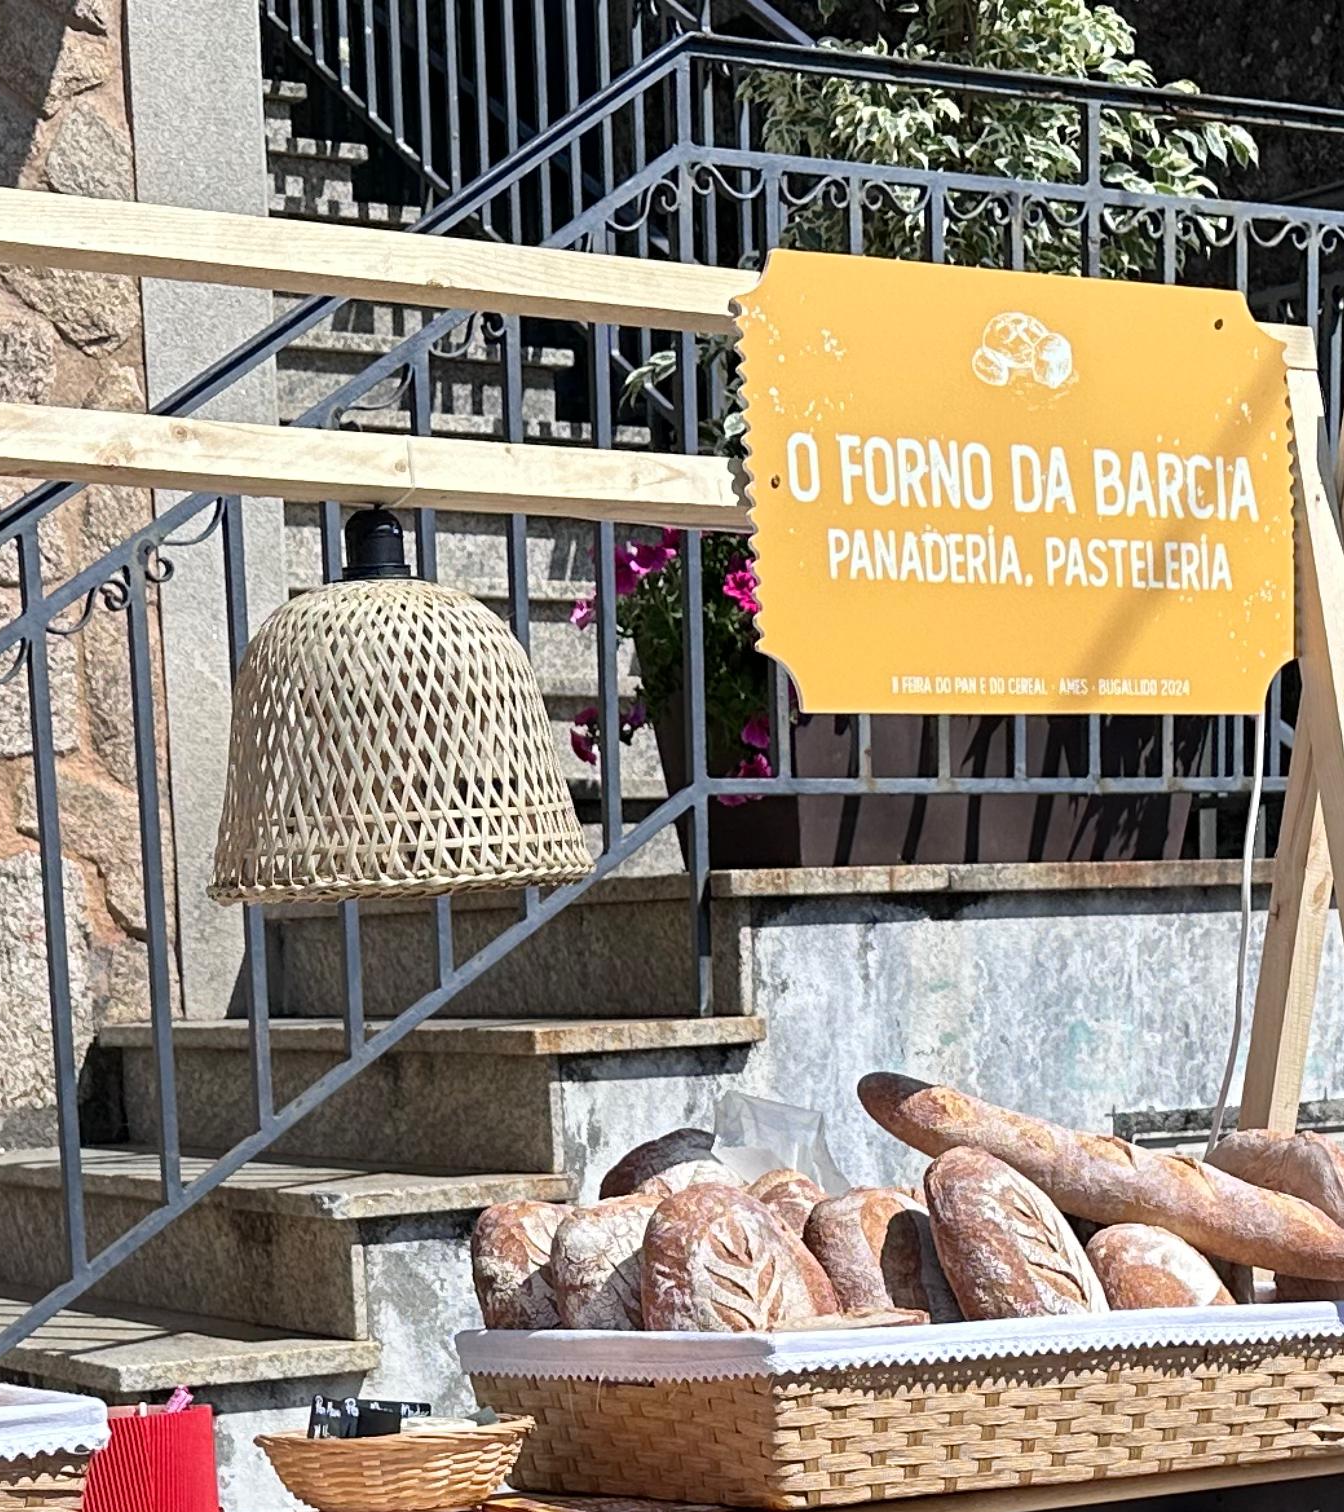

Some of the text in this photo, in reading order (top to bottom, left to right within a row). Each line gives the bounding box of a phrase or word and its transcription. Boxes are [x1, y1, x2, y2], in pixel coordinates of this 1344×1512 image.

[787, 432, 1259, 523] O FORNO DA BARCIA
[1045, 533, 1233, 591] PASTELERÍA
[902, 676, 932, 694] FEIRA
[936, 676, 951, 694] DO
[955, 676, 977, 694] PAN
[980, 677, 986, 695] E
[989, 677, 1005, 695] DO
[1008, 677, 1048, 695] CEREAL
[1059, 677, 1089, 696] AMES
[1098, 678, 1157, 696] BUGALLIDO
[1160, 679, 1190, 696] 2024
